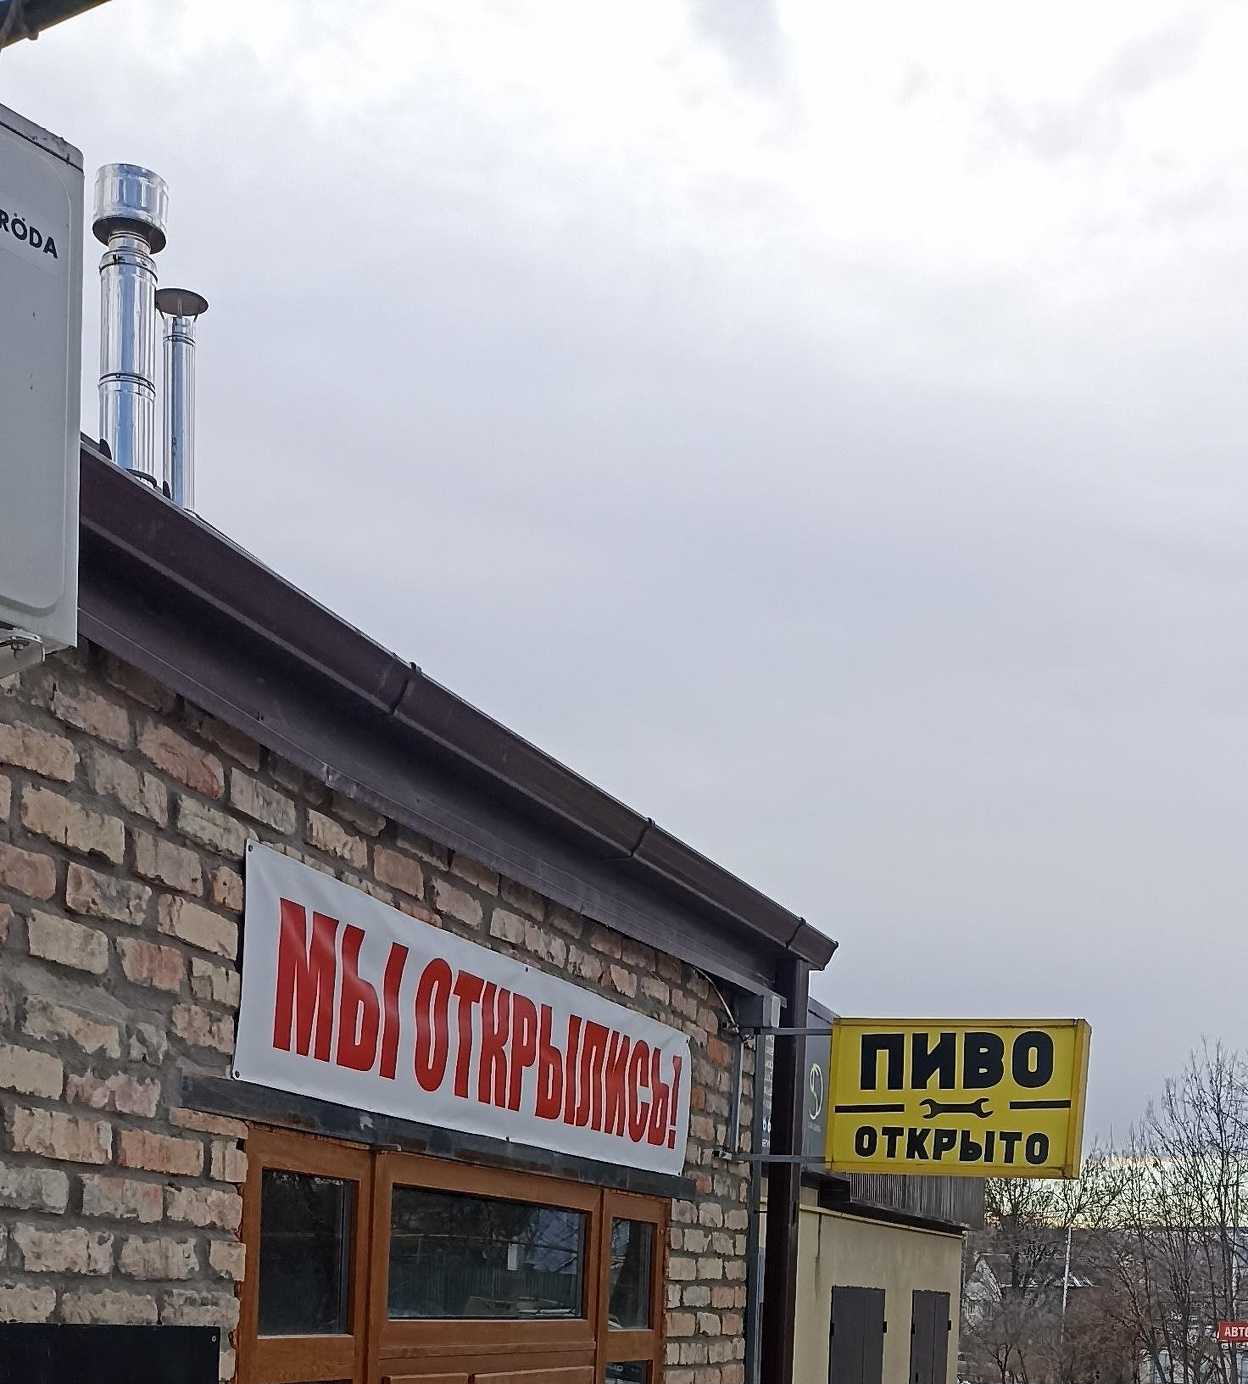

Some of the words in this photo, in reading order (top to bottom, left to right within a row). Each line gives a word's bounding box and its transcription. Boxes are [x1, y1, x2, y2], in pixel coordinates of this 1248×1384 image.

[272, 897, 409, 1080] МЫ
[414, 957, 683, 1150] ОТКРЫЛИСЬ!
[859, 1030, 1054, 1091] ПИВО
[854, 1125, 1050, 1165] ОТКРЫТО
